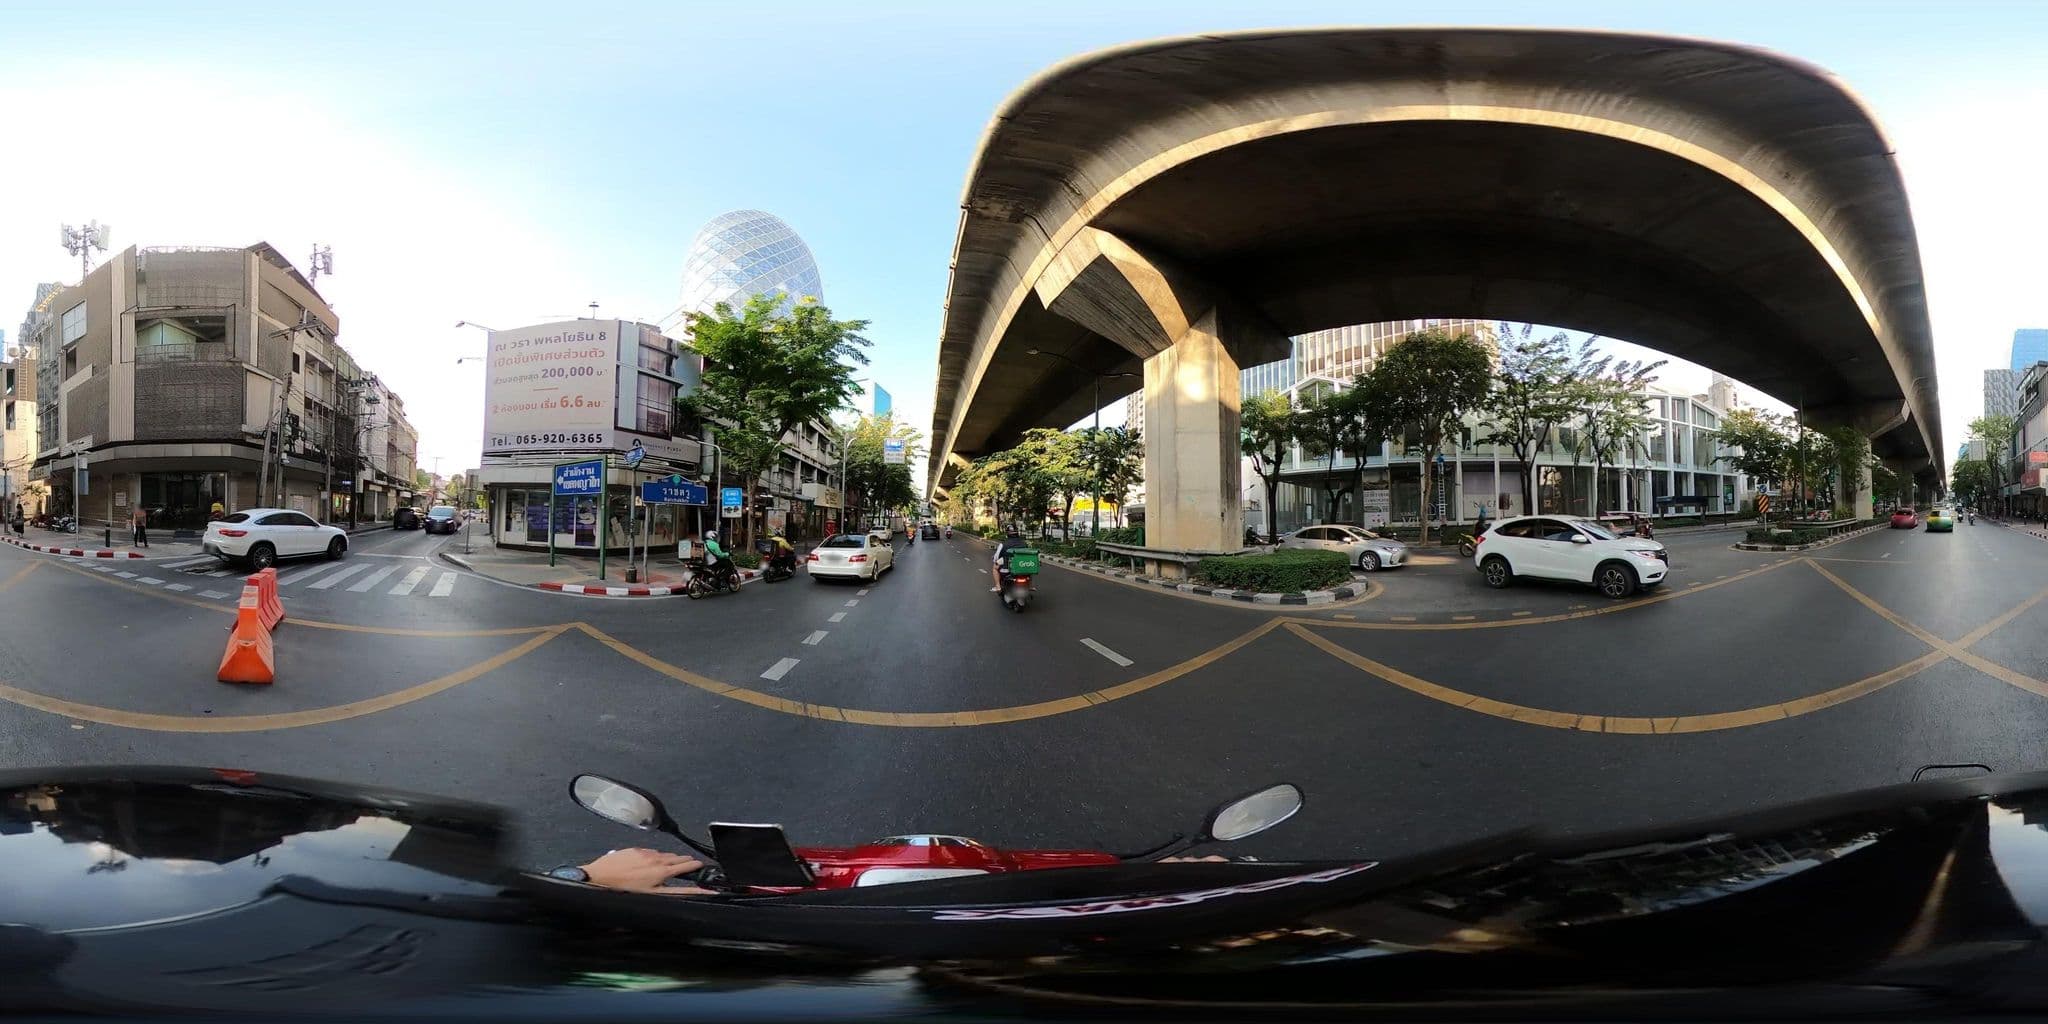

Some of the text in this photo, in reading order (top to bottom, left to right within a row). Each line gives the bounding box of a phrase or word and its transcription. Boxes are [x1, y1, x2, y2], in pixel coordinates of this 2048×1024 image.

[511, 339, 531, 349] วรา
[534, 331, 595, 345] พหลโยธิน
[598, 331, 607, 341] 8
[541, 366, 594, 379] 200,000
[559, 395, 584, 409] 6.6
[491, 433, 603, 447] Tel. 065-920-6365
[563, 466, 595, 477] สำนักงาน
[562, 475, 601, 491] เขตพญาไท
